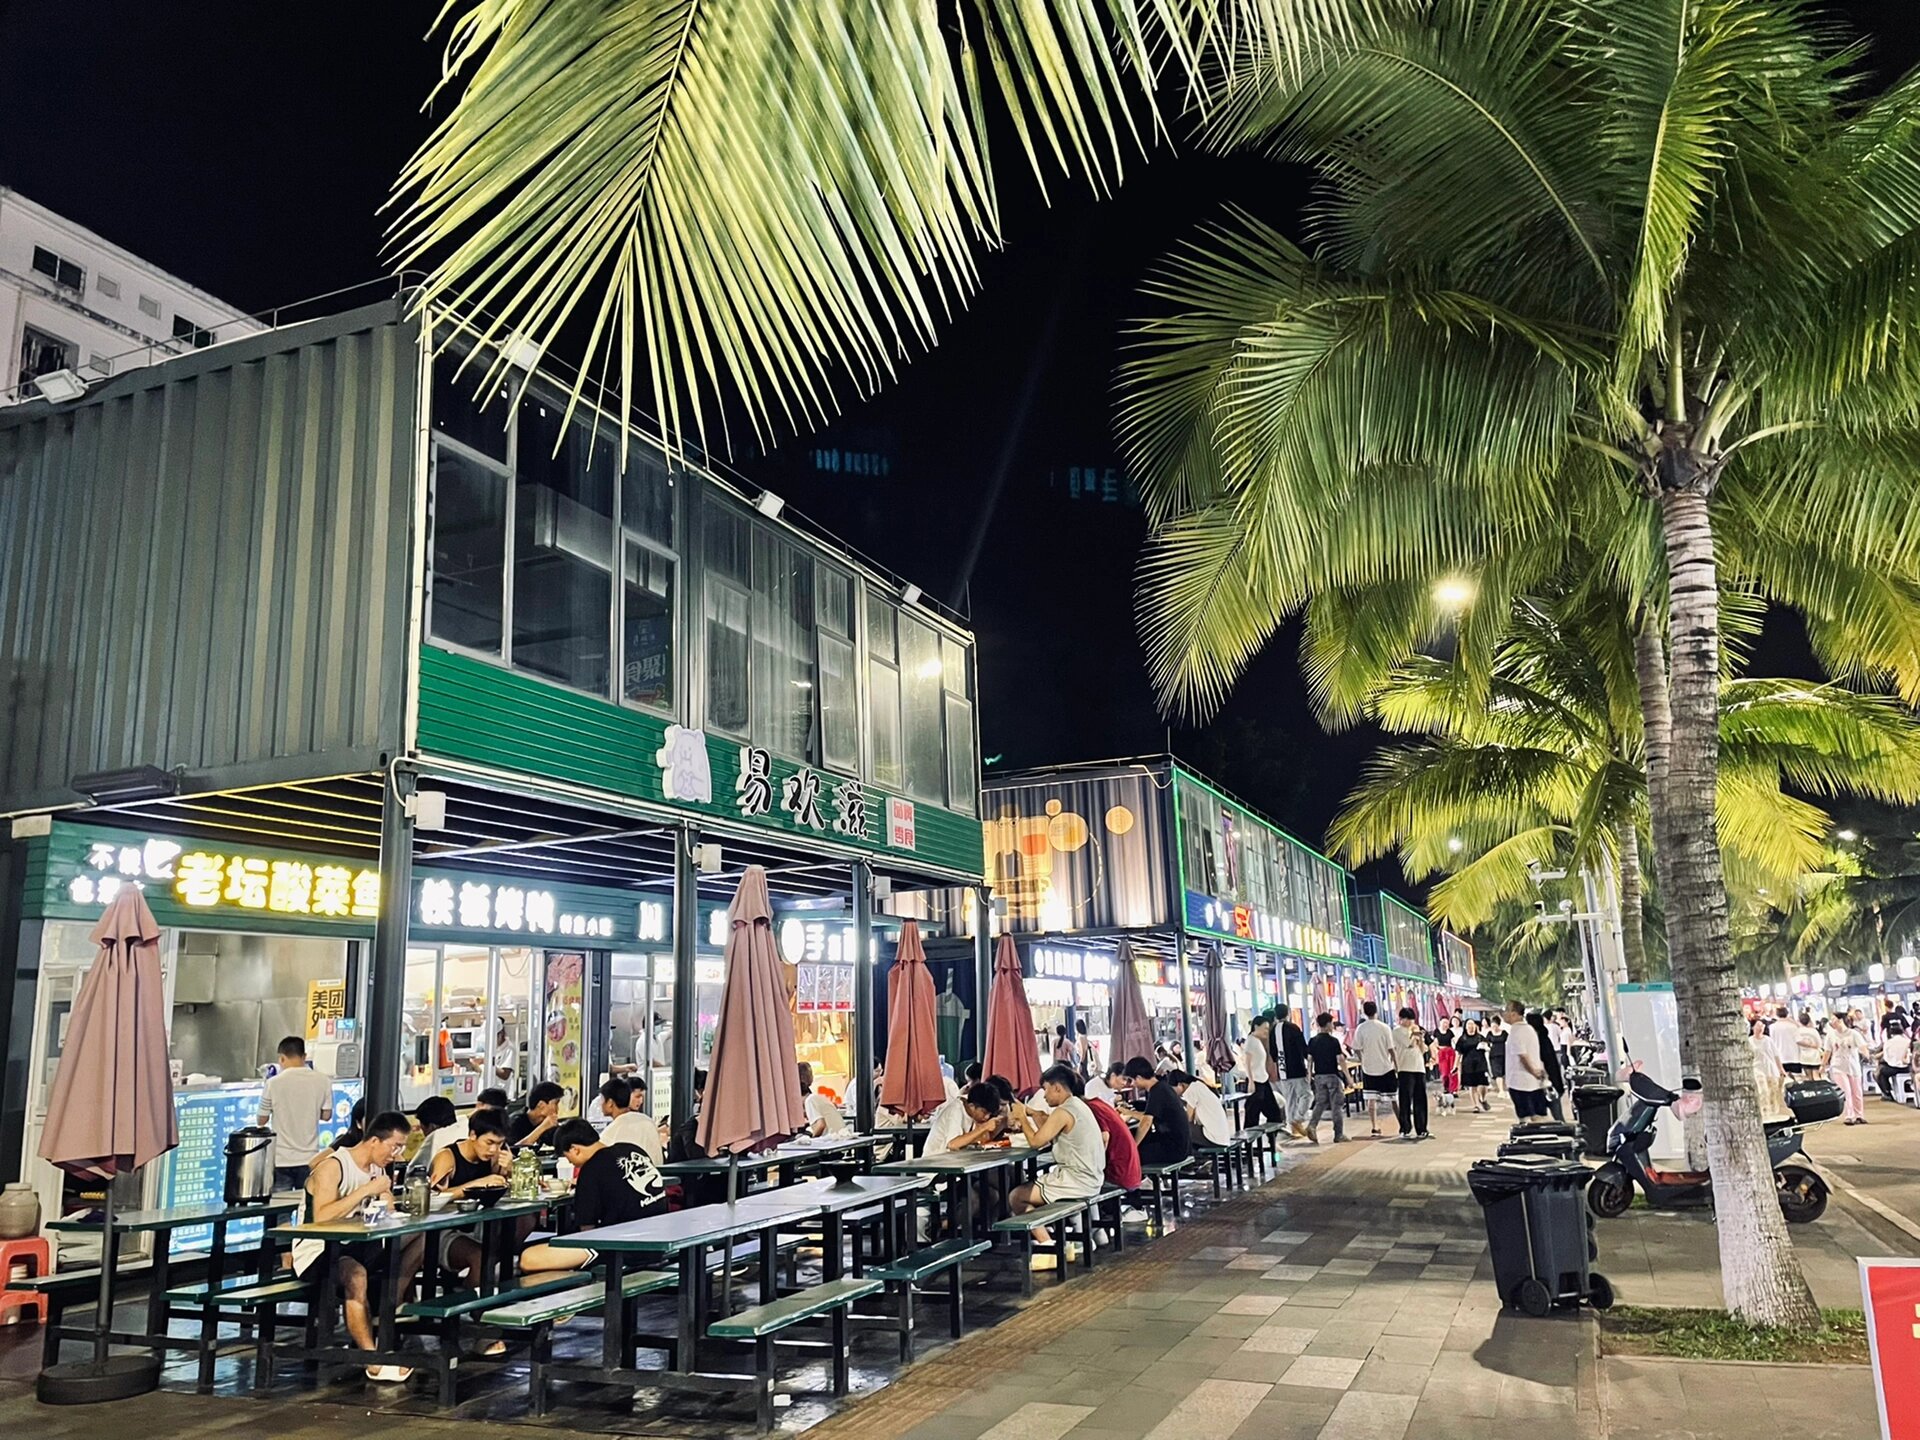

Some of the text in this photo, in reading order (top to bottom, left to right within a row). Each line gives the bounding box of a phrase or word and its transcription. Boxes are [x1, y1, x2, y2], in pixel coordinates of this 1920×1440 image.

[176, 852, 380, 916] 老坛酸菜鱼
[311, 989, 345, 1009] 美团
